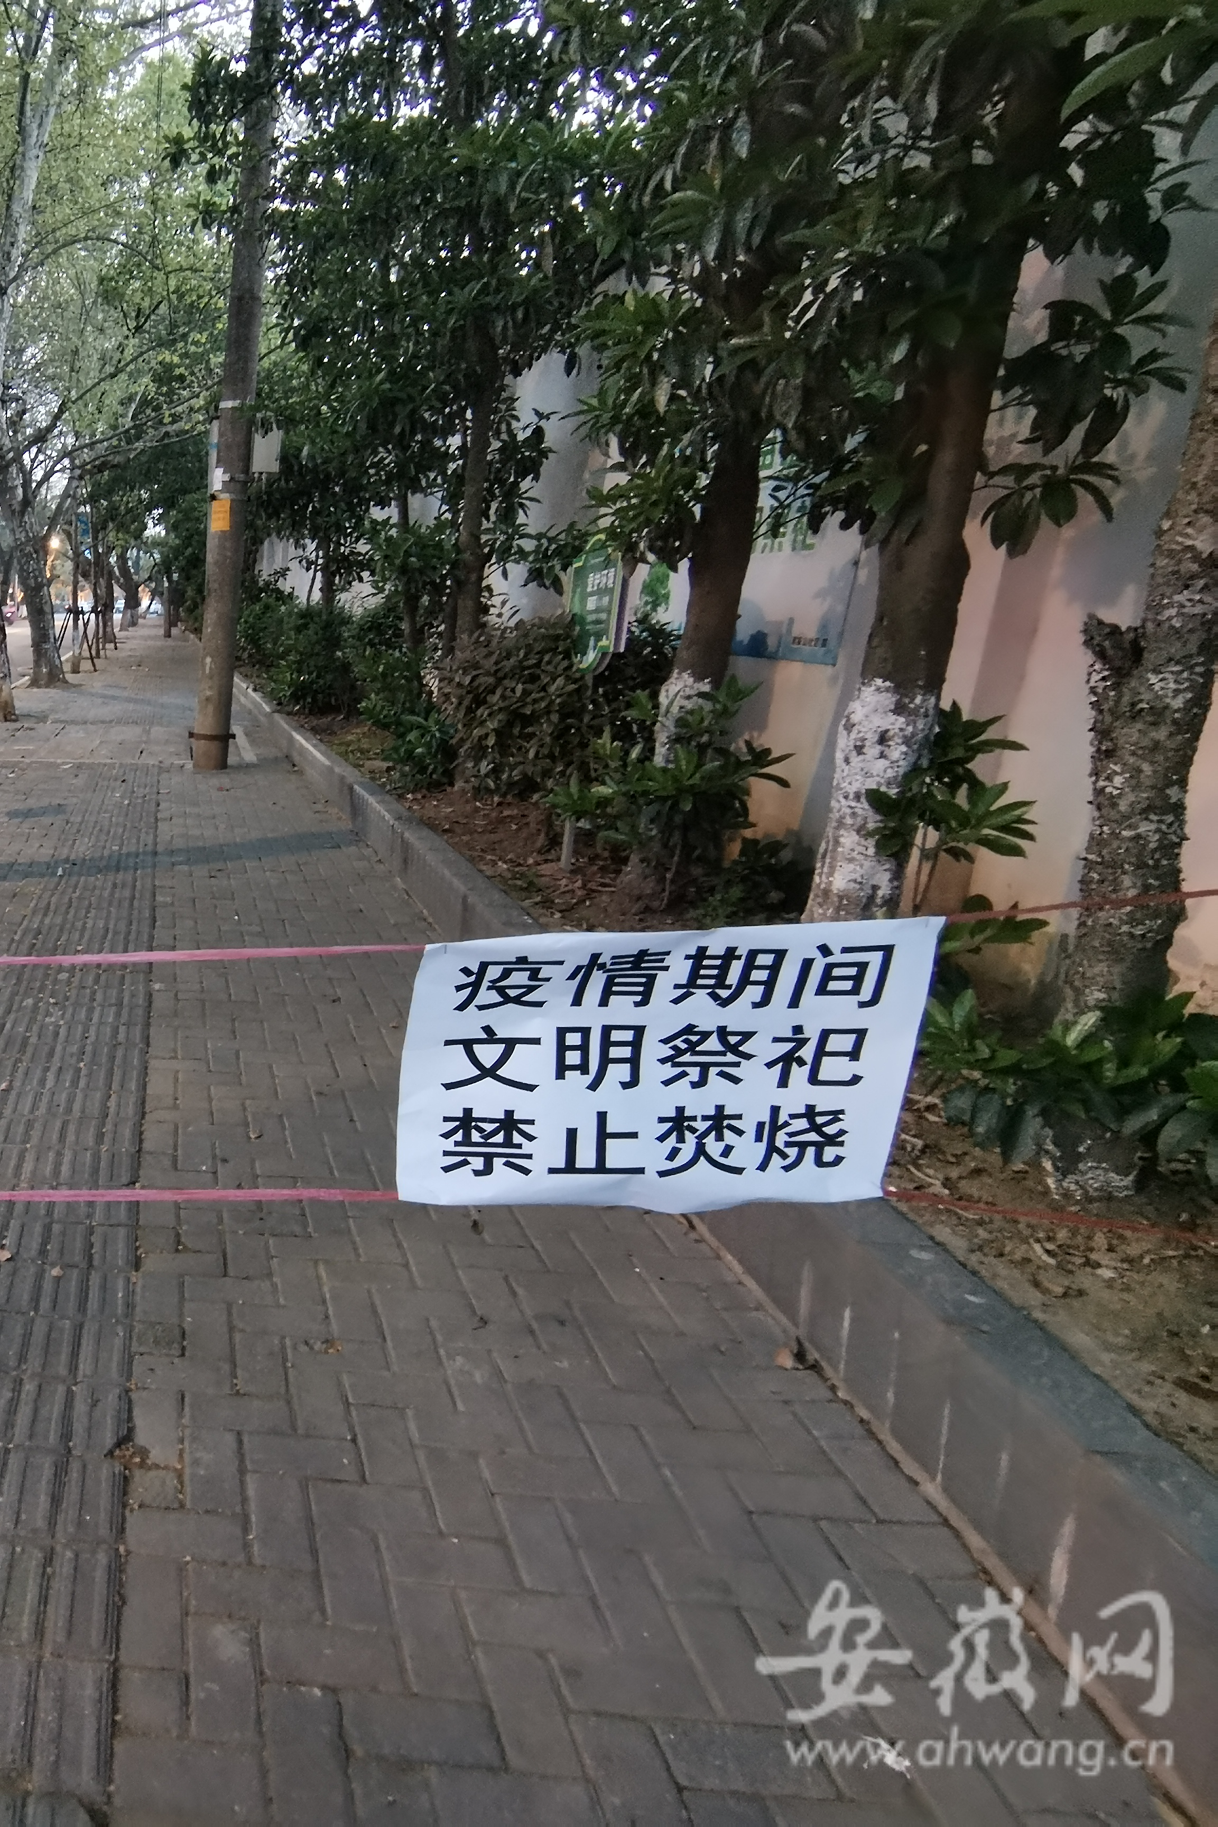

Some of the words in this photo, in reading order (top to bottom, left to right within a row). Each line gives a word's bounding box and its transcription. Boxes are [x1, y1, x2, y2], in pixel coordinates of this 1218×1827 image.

[454, 943, 896, 1012] 疫情期间
[440, 1023, 869, 1092] 文明祭祀
[439, 1104, 849, 1178] 禁止焚烧
